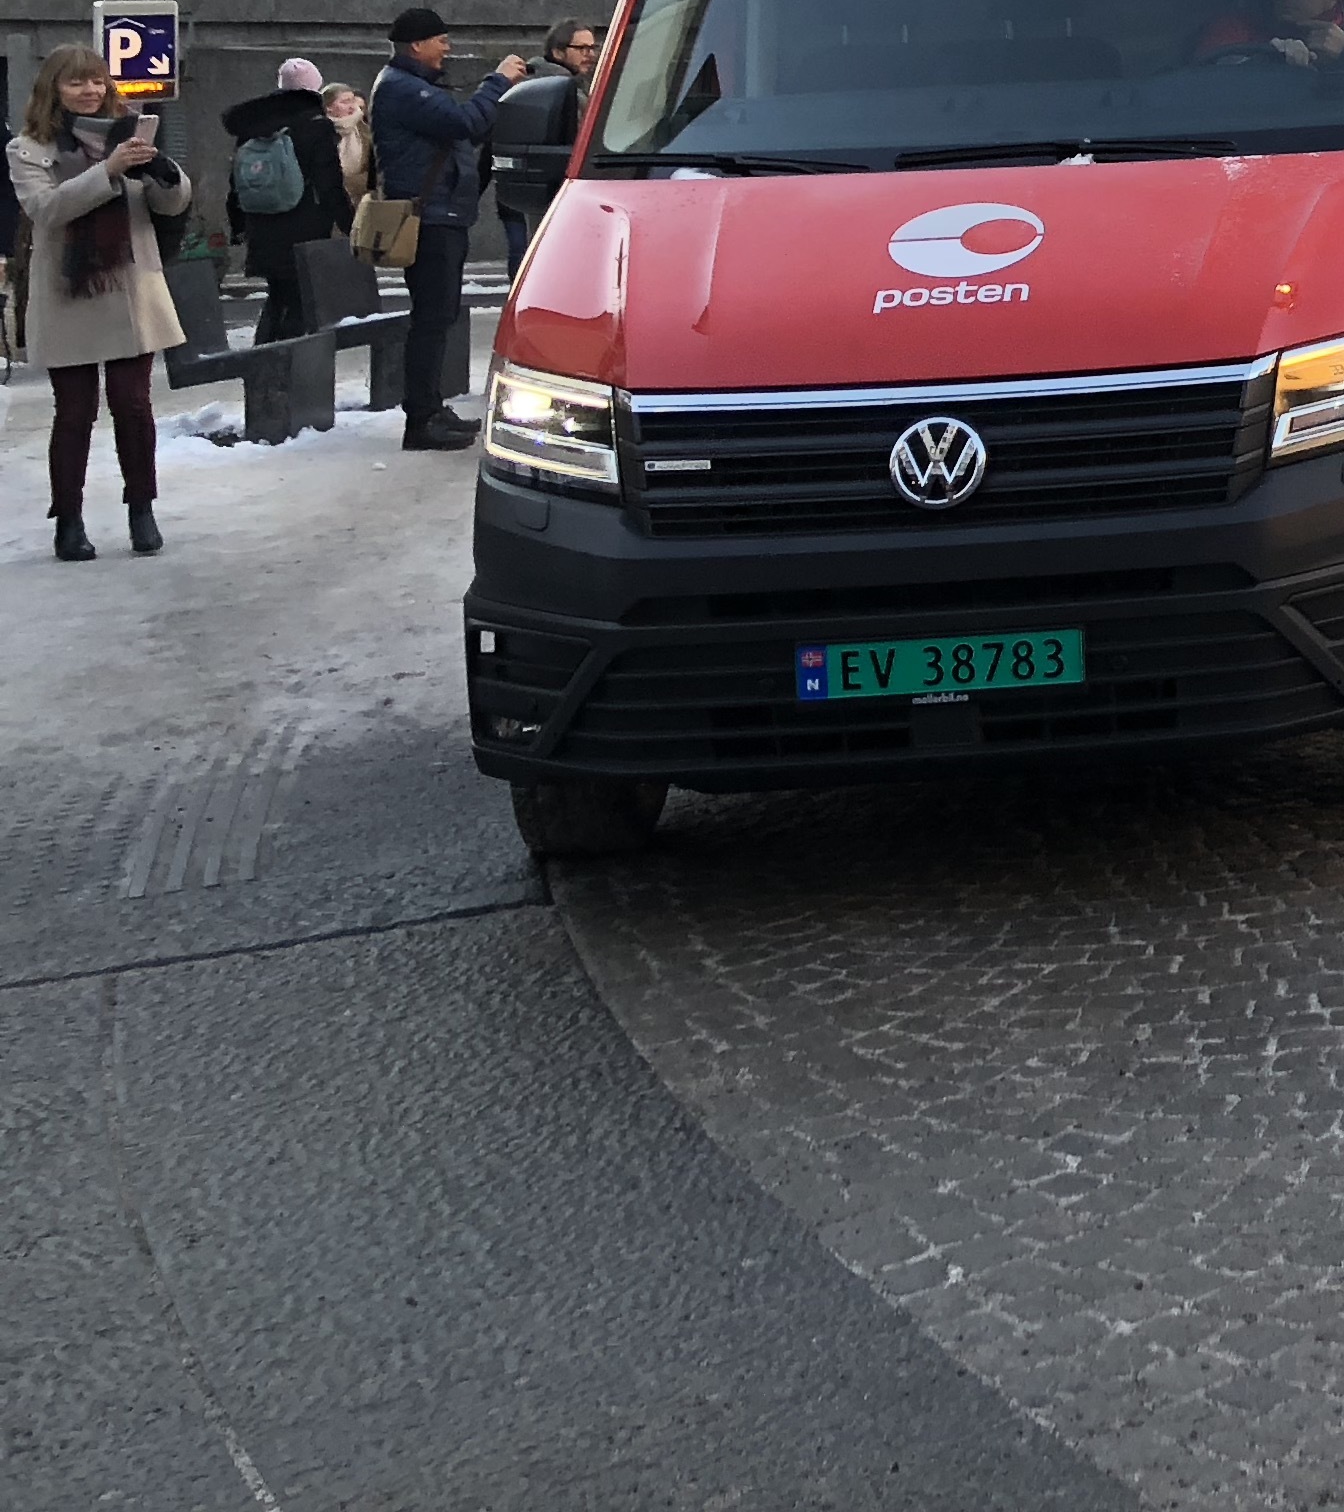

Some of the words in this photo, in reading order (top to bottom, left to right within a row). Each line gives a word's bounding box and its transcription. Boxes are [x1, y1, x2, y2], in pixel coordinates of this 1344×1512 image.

[109, 28, 142, 76] P
[872, 281, 1030, 314] posten
[806, 678, 820, 691] N
[840, 647, 896, 691] EV
[922, 638, 1065, 687] 38783
